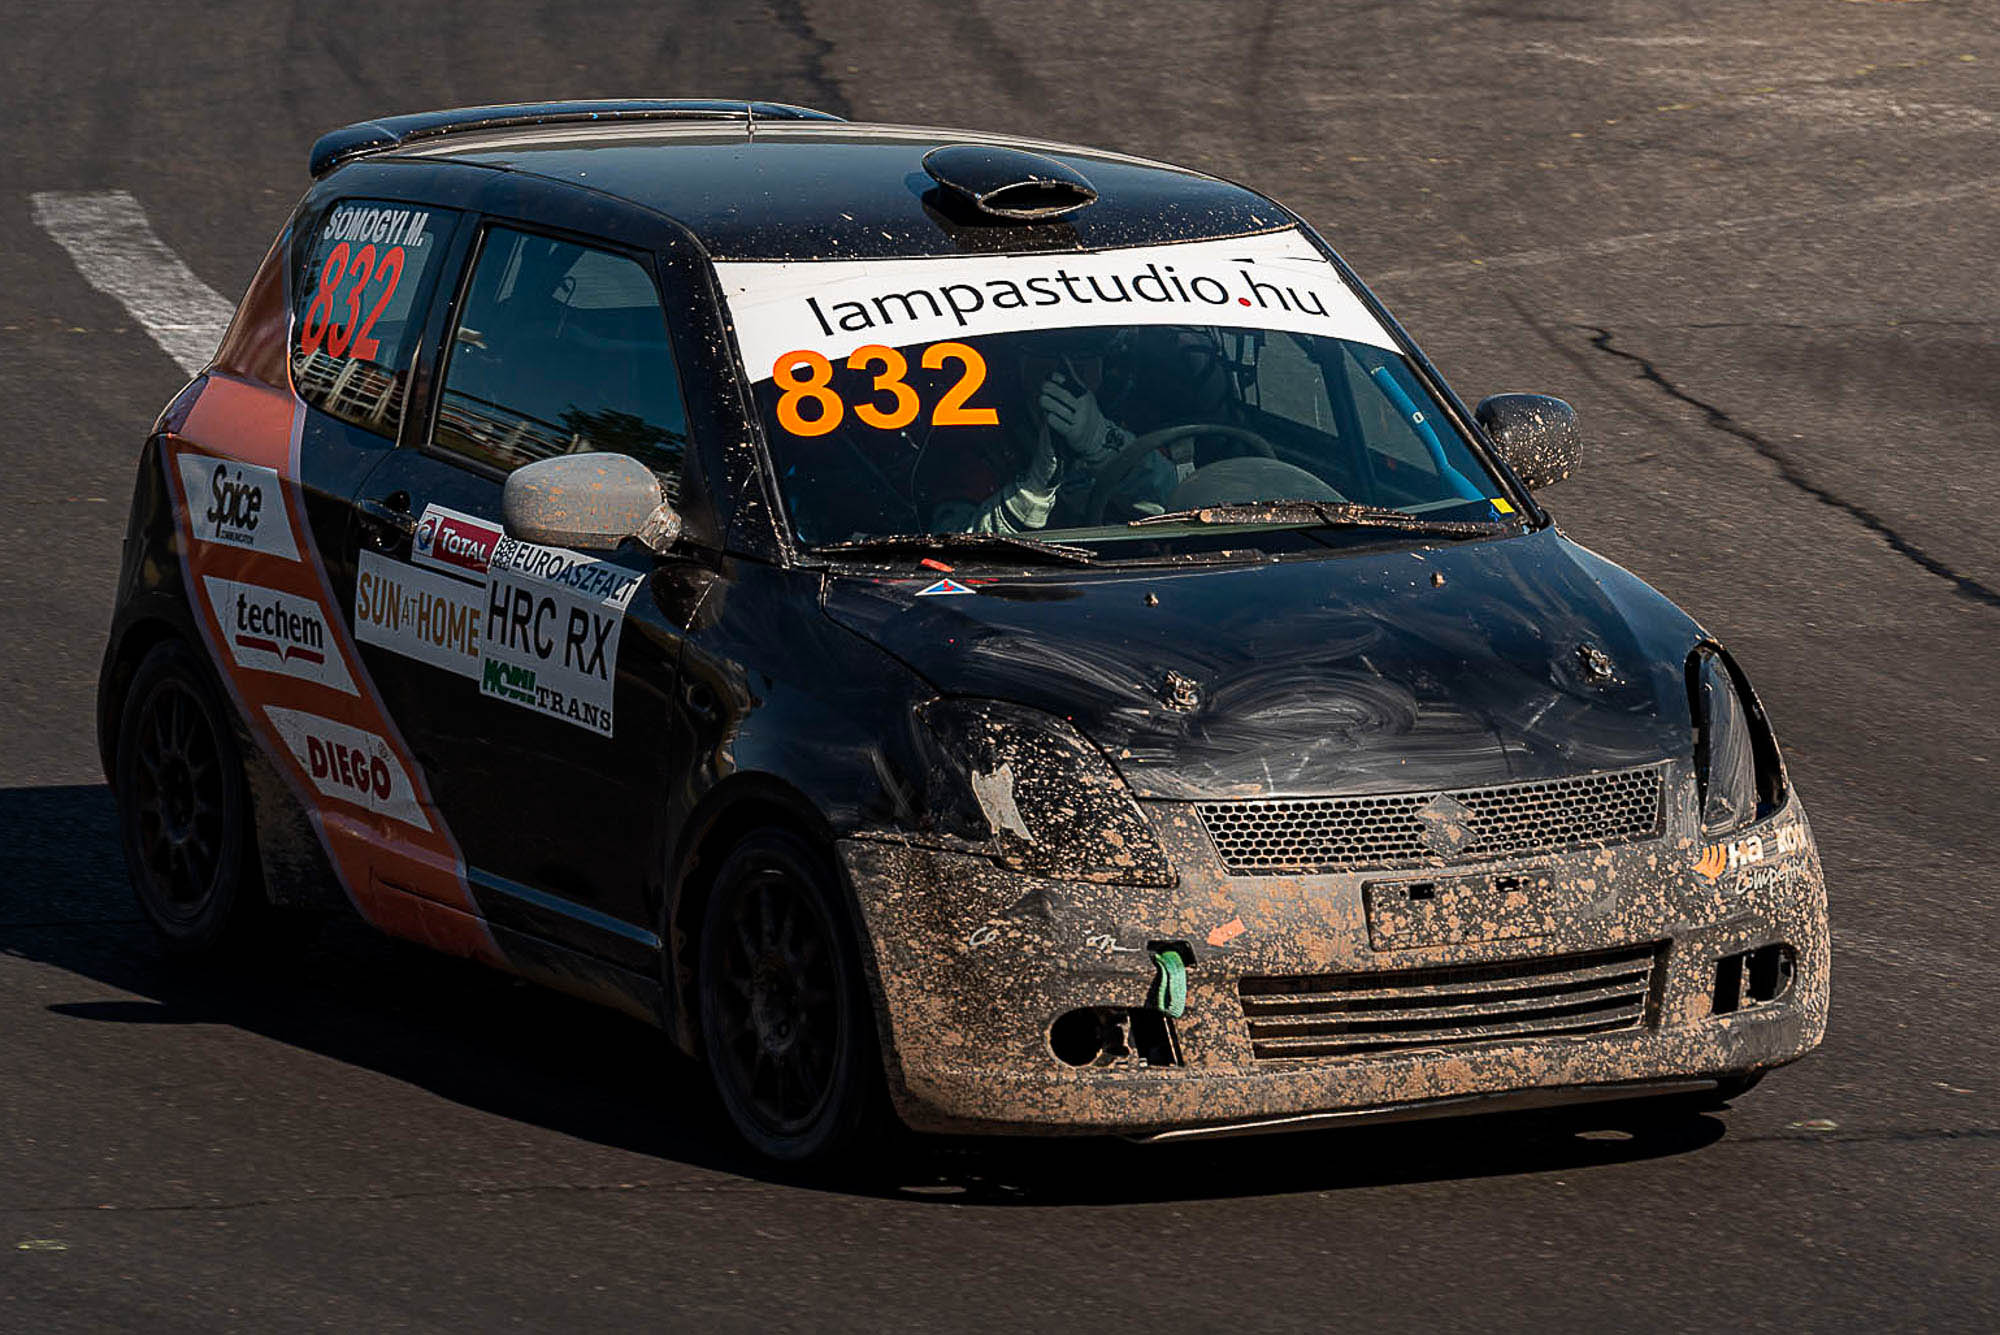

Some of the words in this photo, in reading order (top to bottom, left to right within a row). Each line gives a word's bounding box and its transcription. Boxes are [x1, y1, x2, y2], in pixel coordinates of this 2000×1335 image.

[324, 206, 410, 244] SOMOGYI
[402, 212, 429, 247] M.
[301, 242, 405, 361] 832
[805, 264, 1330, 337] lampastudio.hu
[772, 342, 1000, 437] 832
[207, 464, 262, 537] Spice
[441, 526, 488, 564] TOTAL
[511, 543, 639, 602] EUROASZFALT
[237, 593, 323, 649] techem
[358, 572, 402, 632] SUN
[417, 592, 481, 658] HOME
[487, 580, 557, 660] HRC
[564, 607, 614, 681] RX
[536, 686, 612, 732] TRANS
[306, 736, 392, 800] DIEGO
